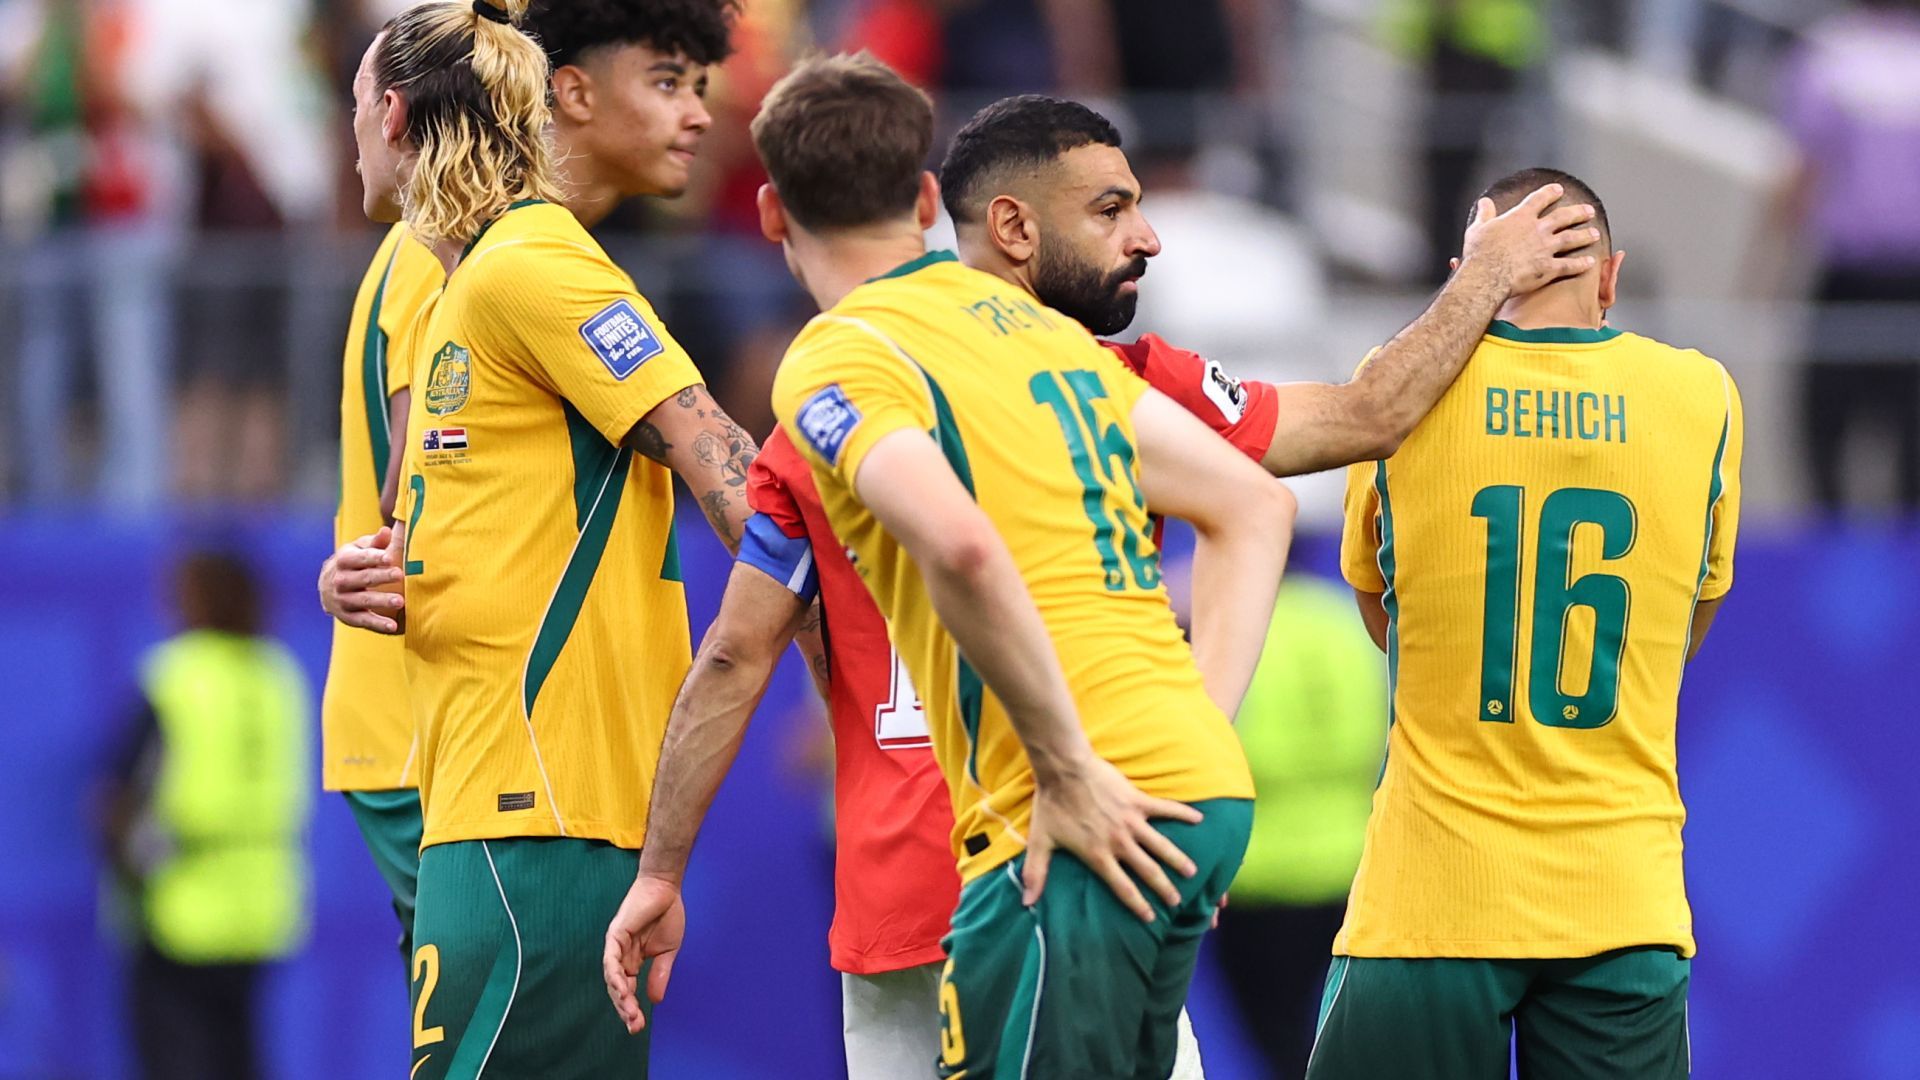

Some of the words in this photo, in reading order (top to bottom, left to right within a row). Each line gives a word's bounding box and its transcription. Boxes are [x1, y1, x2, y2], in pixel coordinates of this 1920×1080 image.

[593, 311, 630, 338] FOOTBALL
[599, 318, 639, 350] UNITES
[609, 346, 625, 362] the
[621, 328, 649, 351] World
[1485, 386, 1627, 444] BEHICH
[1470, 484, 1639, 730] 16
[413, 943, 445, 1049] 2
